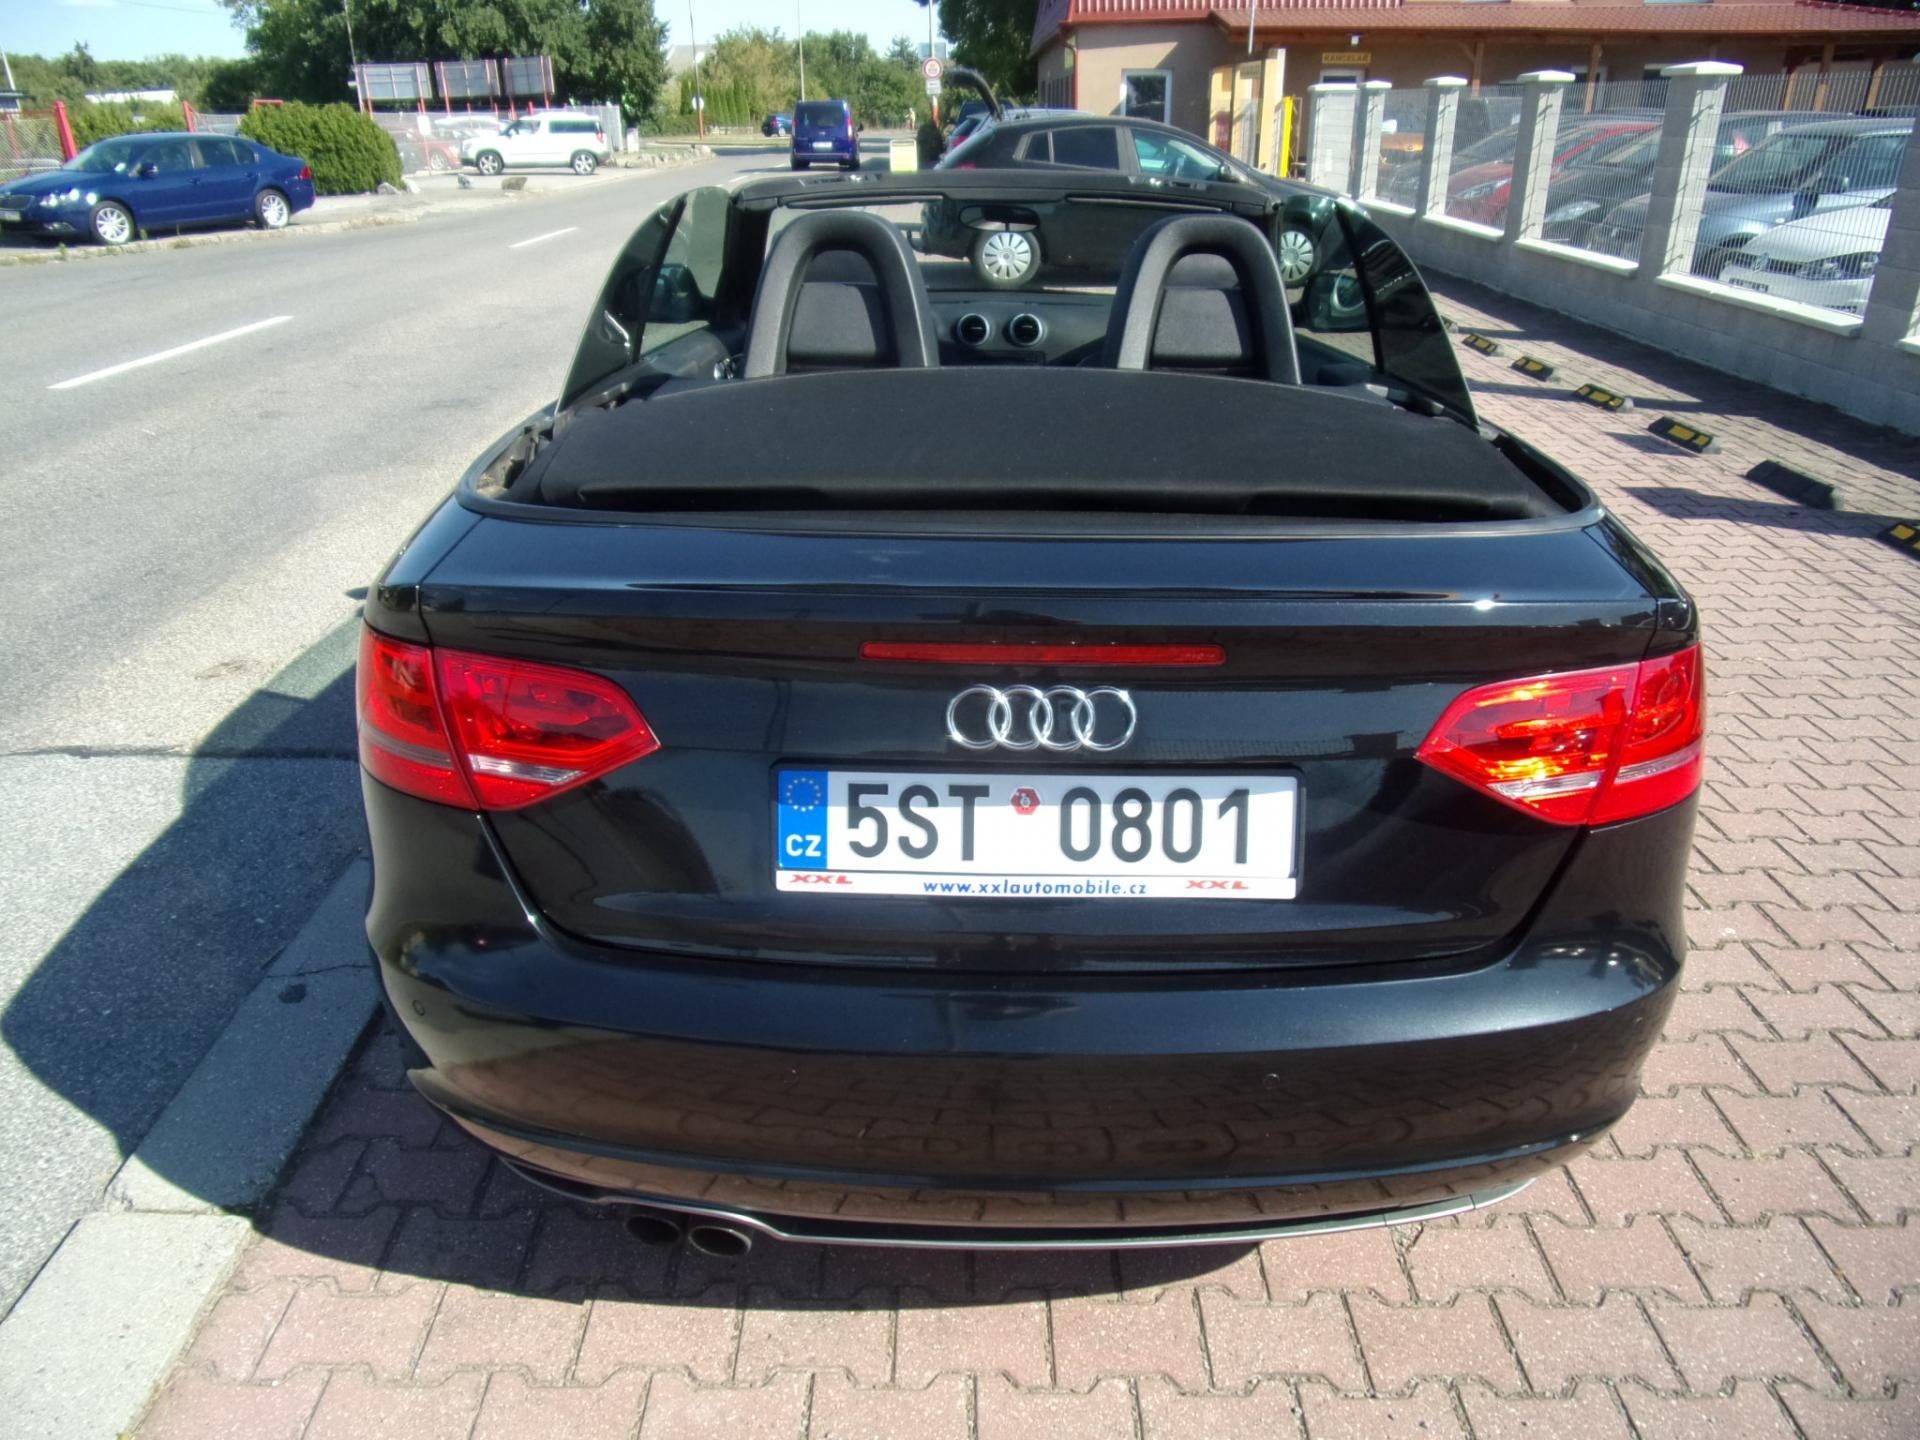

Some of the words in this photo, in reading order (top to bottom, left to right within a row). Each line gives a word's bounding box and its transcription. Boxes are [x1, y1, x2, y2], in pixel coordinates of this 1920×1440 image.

[848, 783, 990, 861] 5ST
[1060, 785, 1249, 864] 0801
[786, 834, 821, 856] CZ
[790, 874, 853, 884] XXL
[923, 879, 1148, 894] www.xxlautomobile.cz
[1185, 880, 1249, 890] XXL
